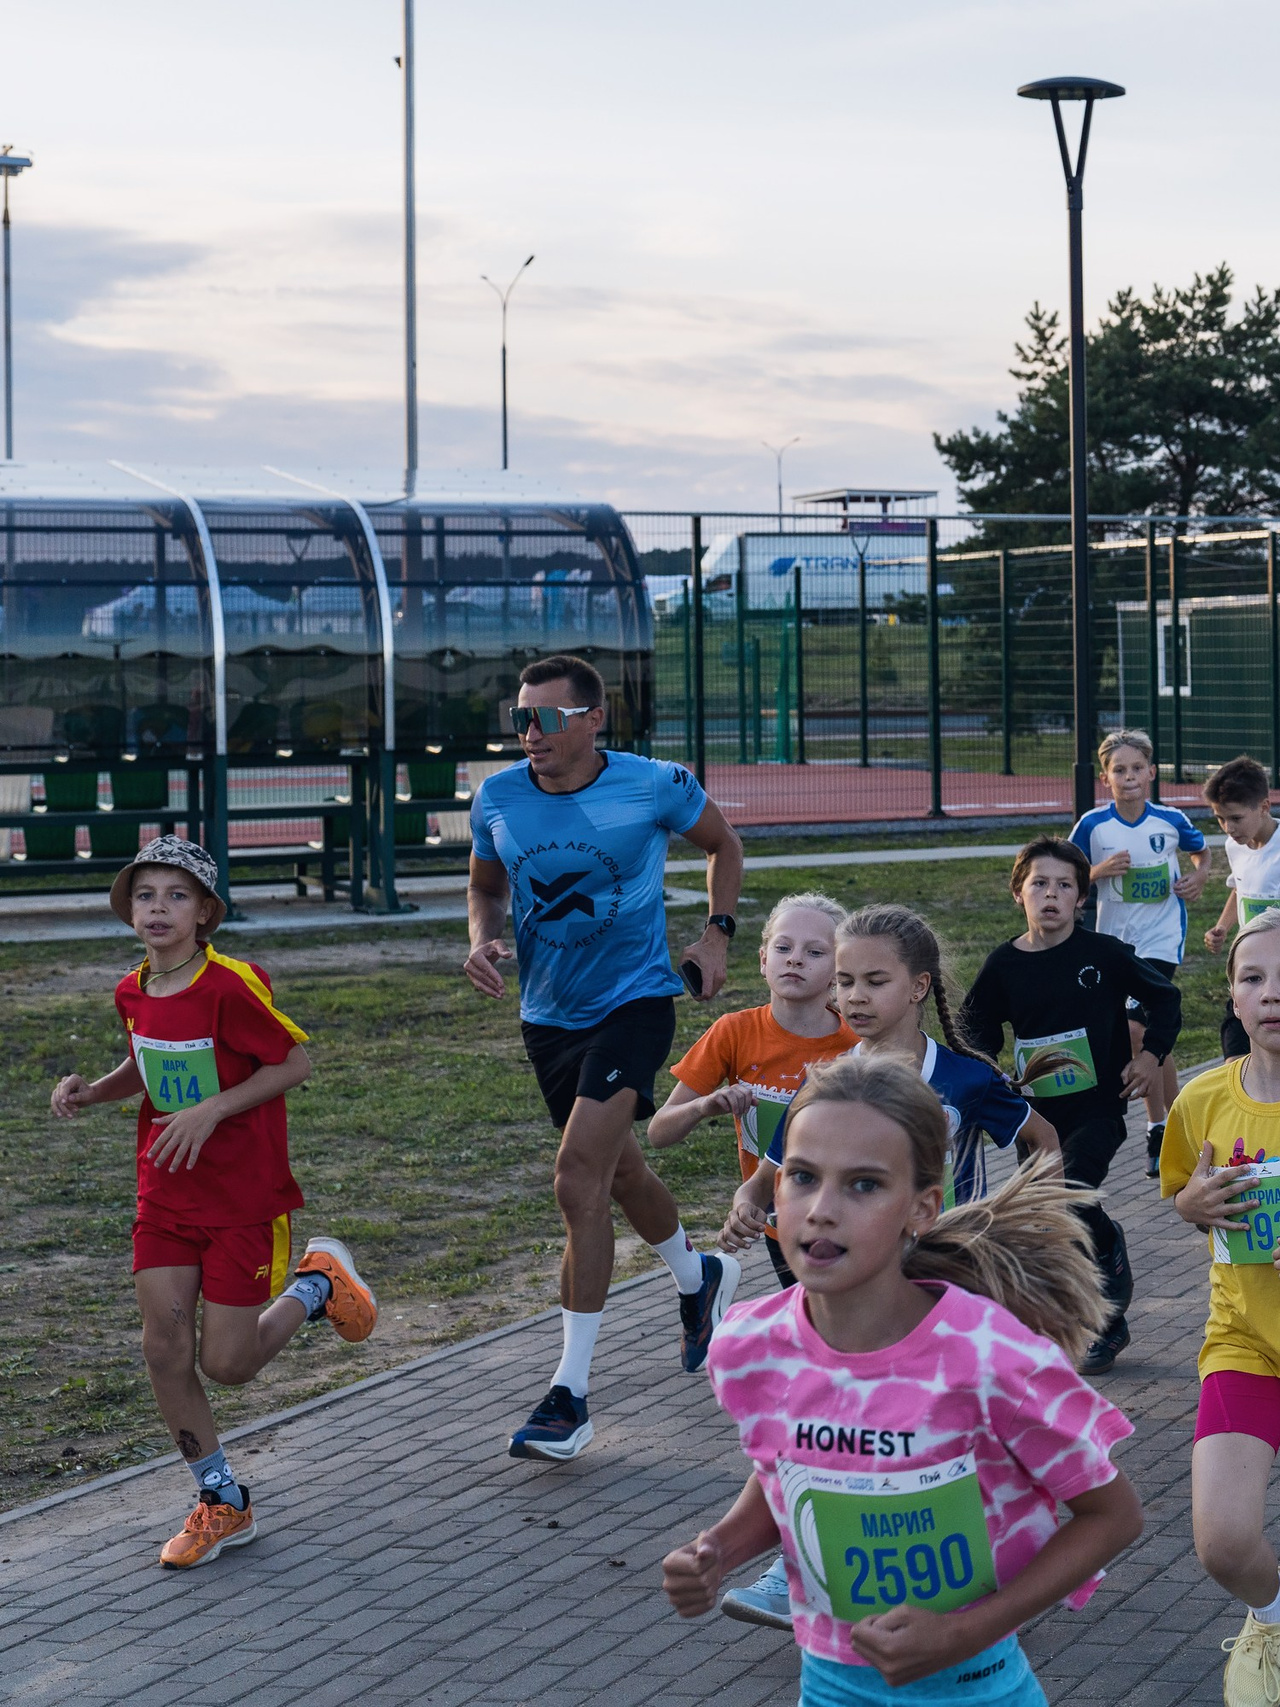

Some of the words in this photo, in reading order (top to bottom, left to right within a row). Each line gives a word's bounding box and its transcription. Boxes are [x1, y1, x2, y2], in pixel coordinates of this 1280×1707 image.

[510, 841, 559, 890] КОМАНДА
[565, 841, 622, 882] ЛЕГКОВА
[1131, 879, 1167, 898] 2628
[574, 899, 621, 949] ЛЕГКОВА
[163, 1059, 188, 1071] МАРК
[159, 1075, 202, 1104] 414
[796, 1423, 915, 1457] HONEST
[919, 1471, 941, 1485] Пэй
[861, 1507, 935, 1537] МАРИЯ
[844, 1533, 974, 1605] 2590
[956, 1658, 1006, 1684] JOMOTO
